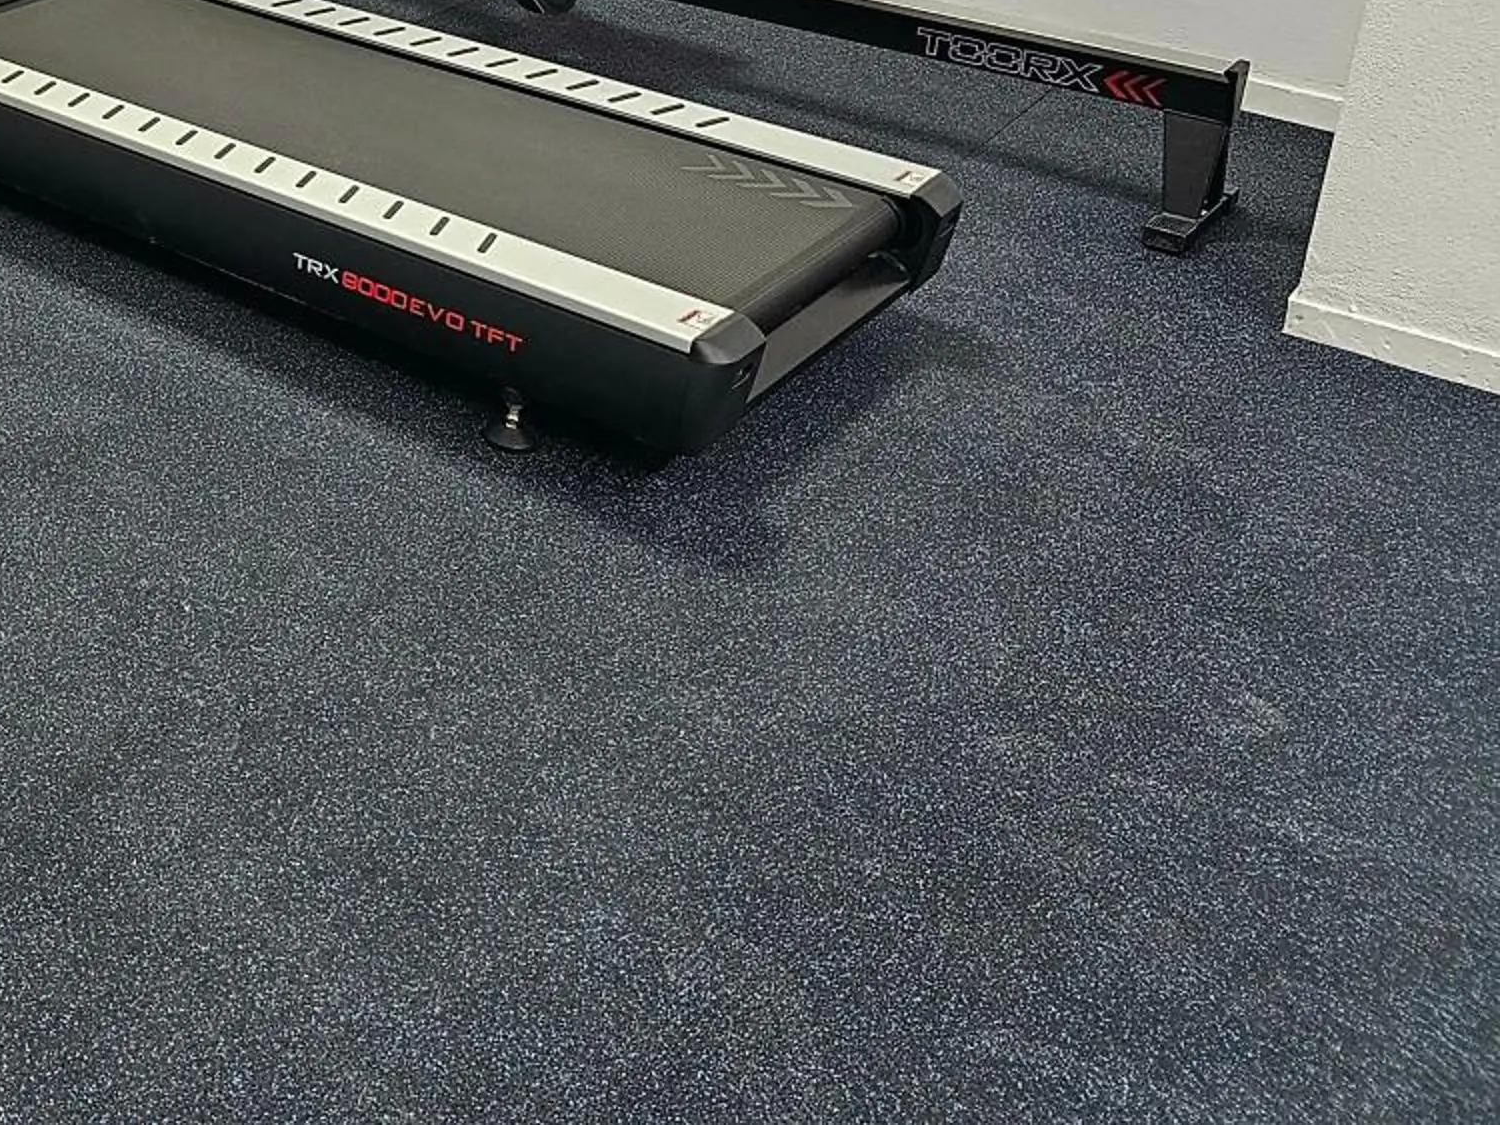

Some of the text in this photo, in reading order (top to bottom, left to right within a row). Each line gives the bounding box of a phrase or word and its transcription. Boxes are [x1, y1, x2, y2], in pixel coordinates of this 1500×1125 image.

[917, 26, 1103, 93] TOORX
[292, 252, 339, 284] TRX
[470, 319, 523, 352] TFT
